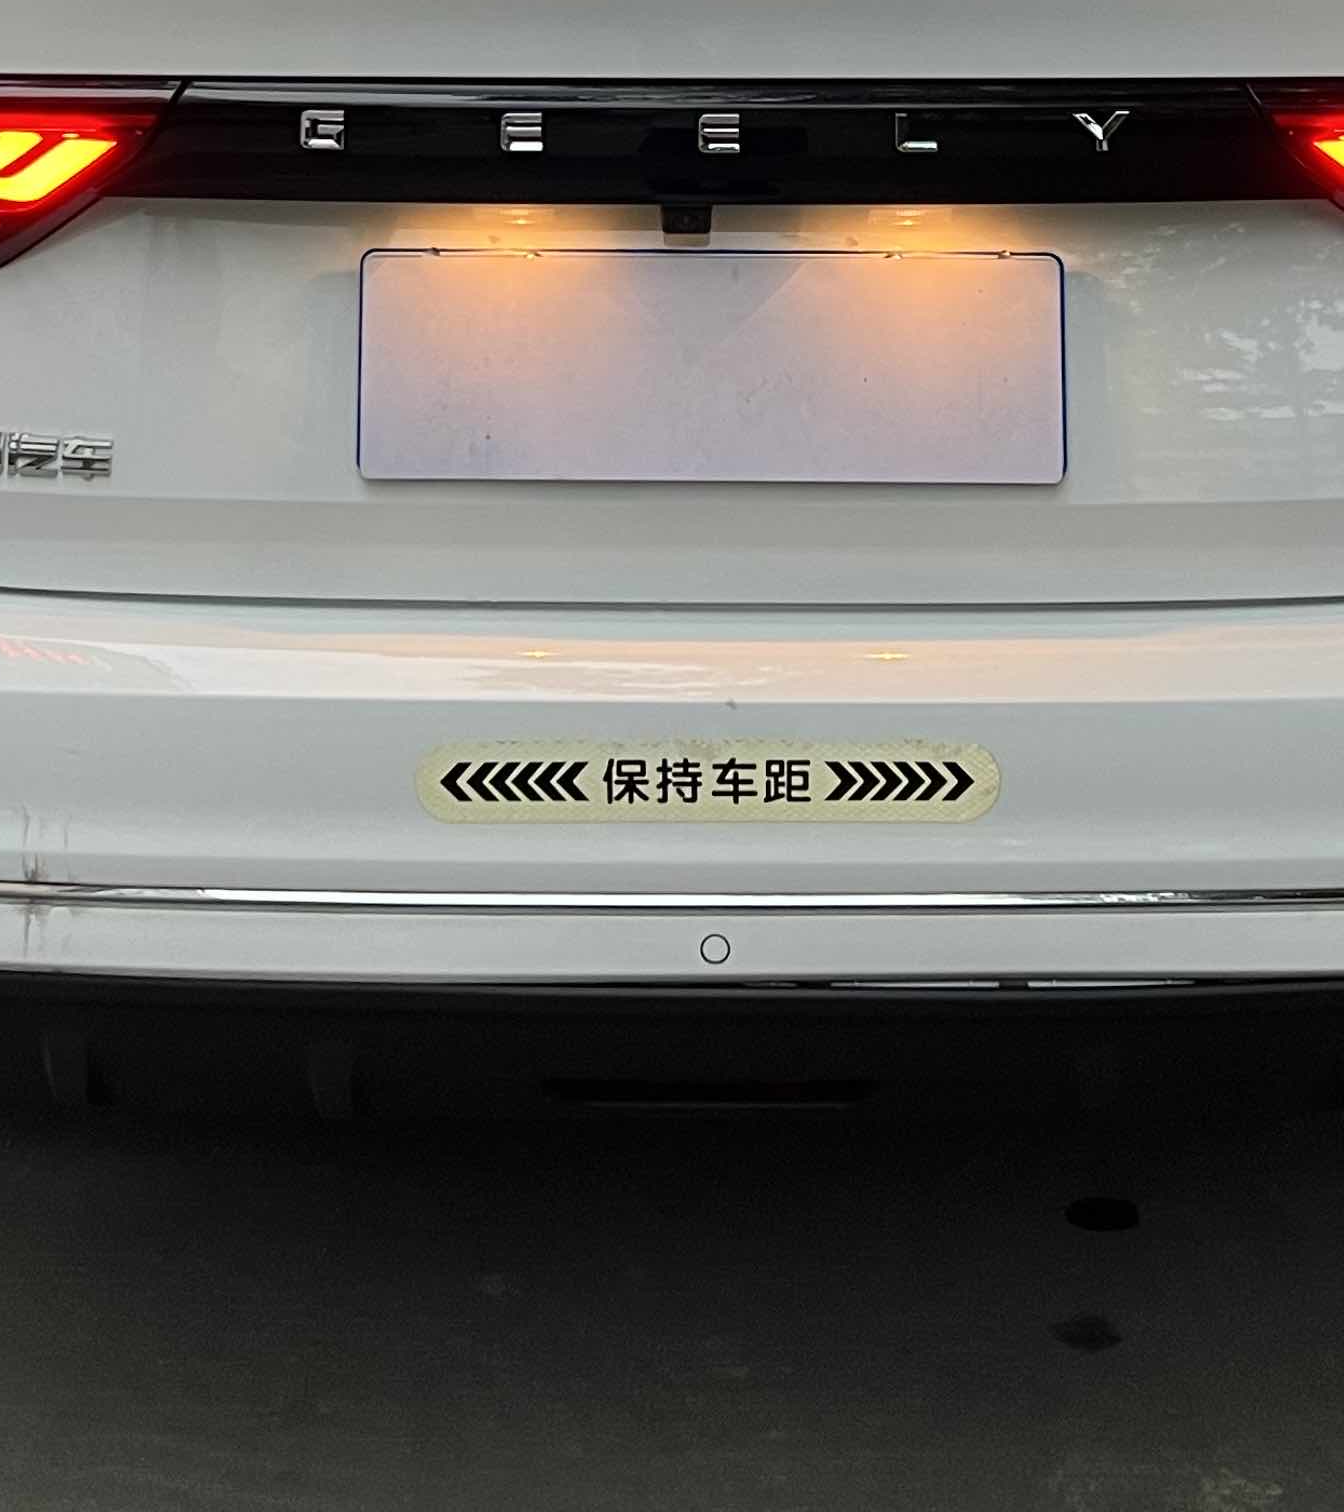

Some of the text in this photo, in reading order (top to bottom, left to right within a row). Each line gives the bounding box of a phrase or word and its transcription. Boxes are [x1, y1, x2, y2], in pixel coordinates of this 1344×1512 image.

[299, 108, 1132, 153] GEELY
[602, 757, 812, 805] 保持车距
